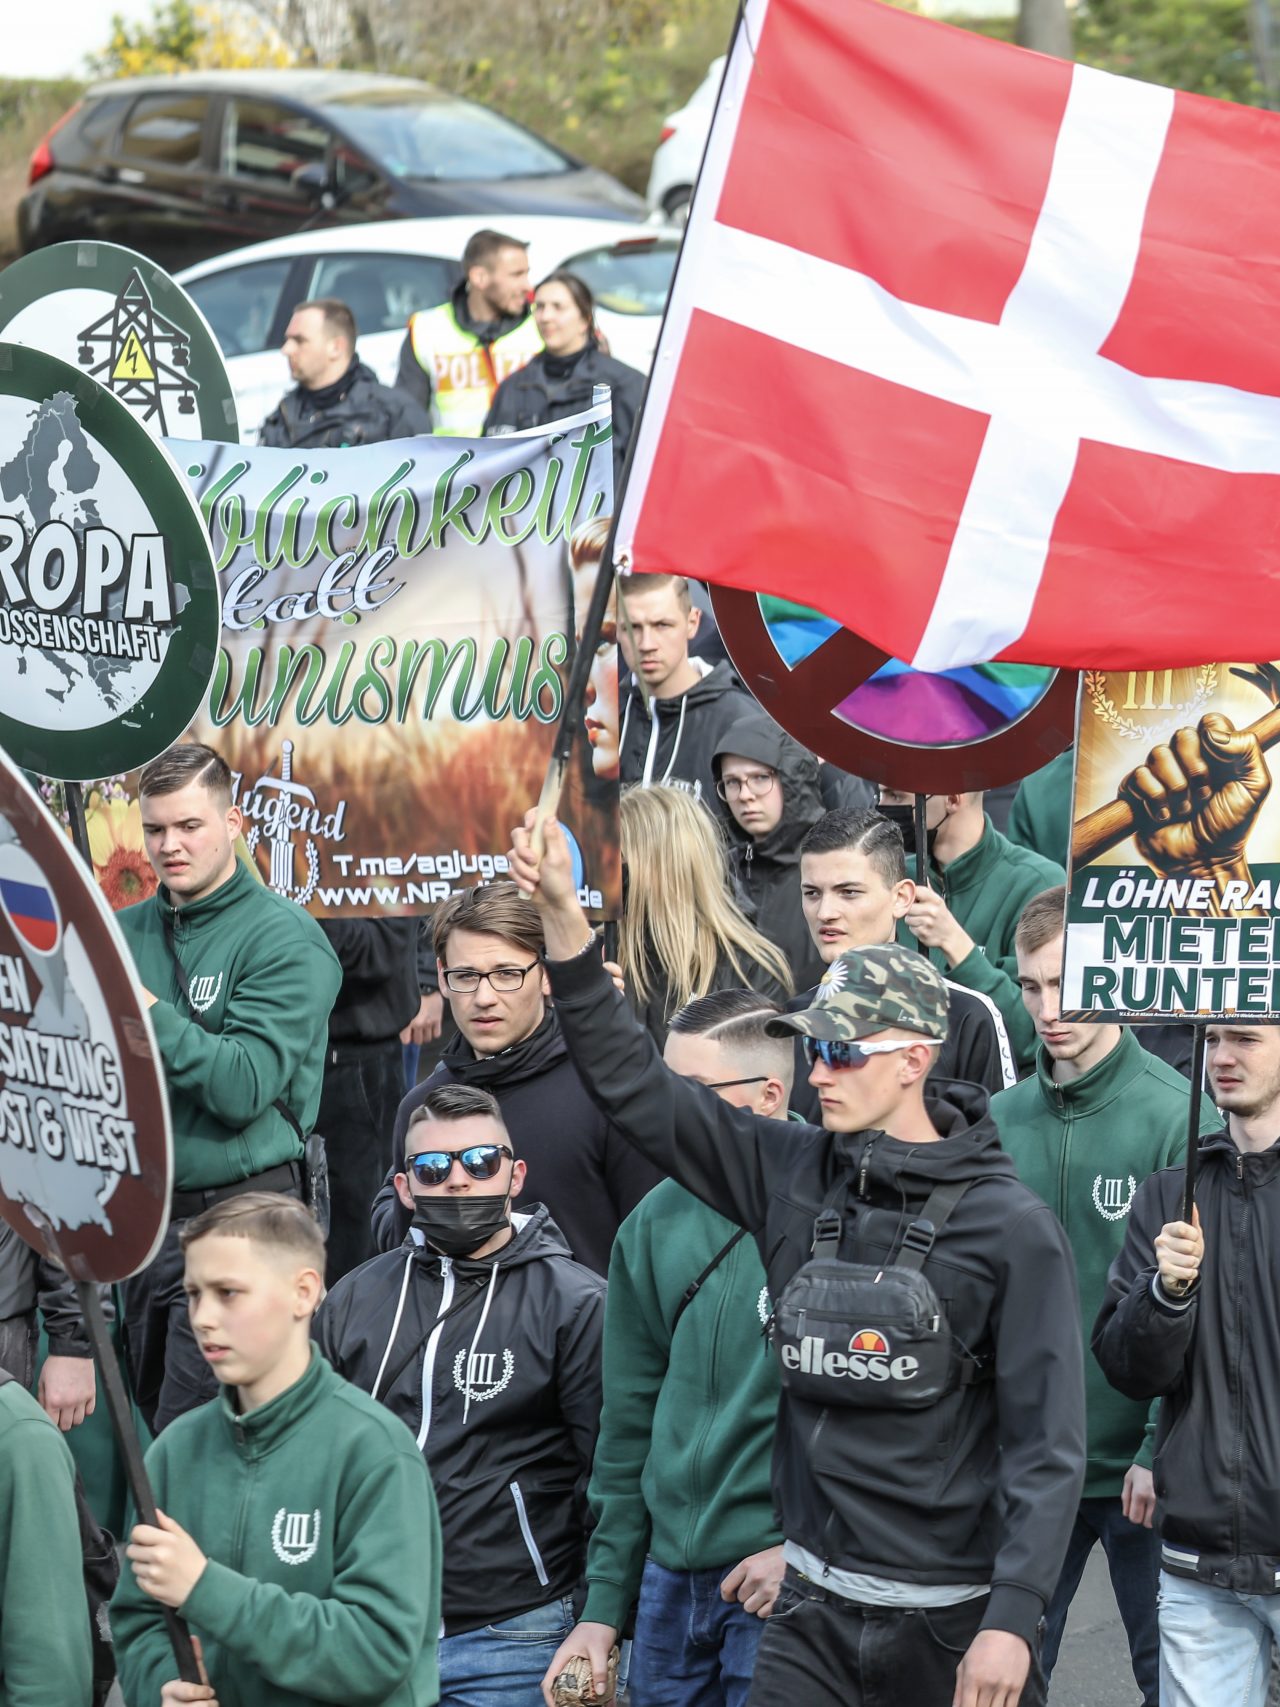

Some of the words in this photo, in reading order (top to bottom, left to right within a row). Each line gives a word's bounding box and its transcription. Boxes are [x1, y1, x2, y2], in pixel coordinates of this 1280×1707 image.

[434, 350, 535, 390] POLIZ
[187, 421, 613, 572] blichkeit
[1081, 870, 1217, 910] LÖHNE
[0, 1088, 36, 1151] ST
[34, 1095, 66, 1159] &
[62, 1102, 143, 1178] WEST
[780, 1335, 920, 1382] ellesse
